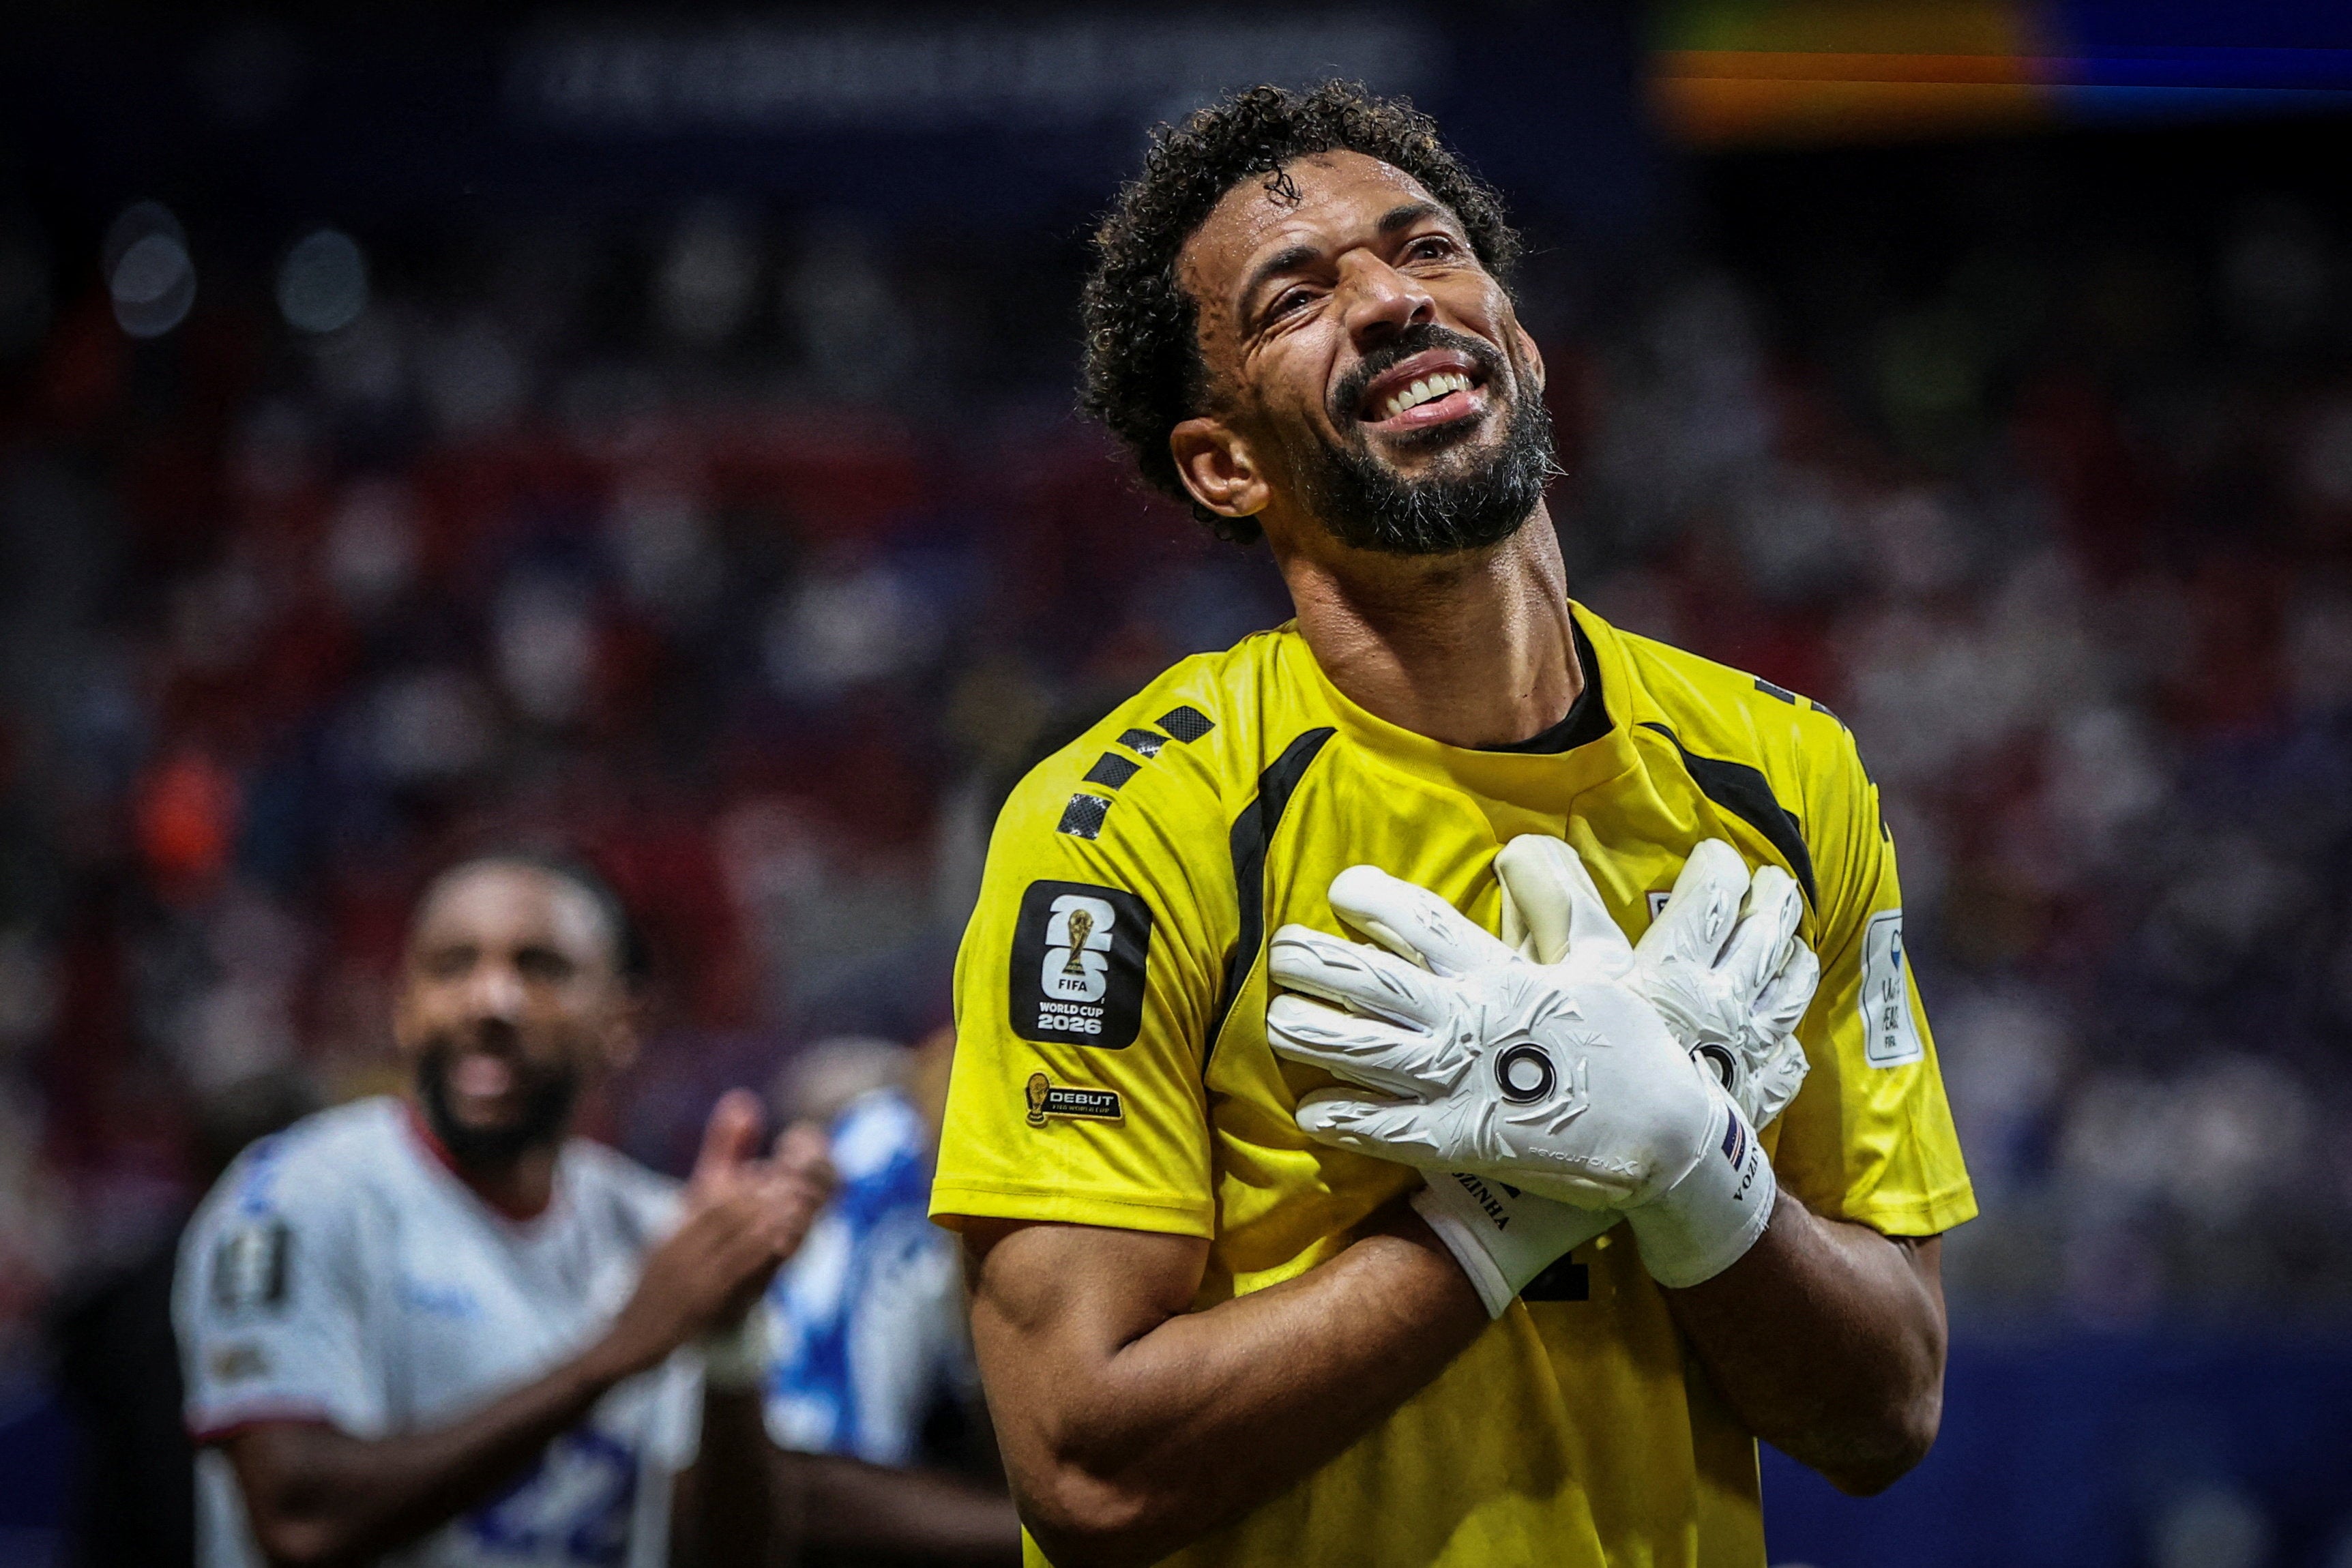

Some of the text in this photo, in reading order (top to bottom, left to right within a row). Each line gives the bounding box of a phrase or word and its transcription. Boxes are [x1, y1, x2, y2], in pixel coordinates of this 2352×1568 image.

[1058, 979, 1087, 992] FIFA
[1040, 1001, 1104, 1018] WORLD CUP
[1038, 1014, 1102, 1035] 2026
[1050, 1092, 1114, 1106] DEBUT
[1528, 1147, 1638, 1177] REVOLUTION X
[1452, 1172, 1510, 1230] ZINHA
